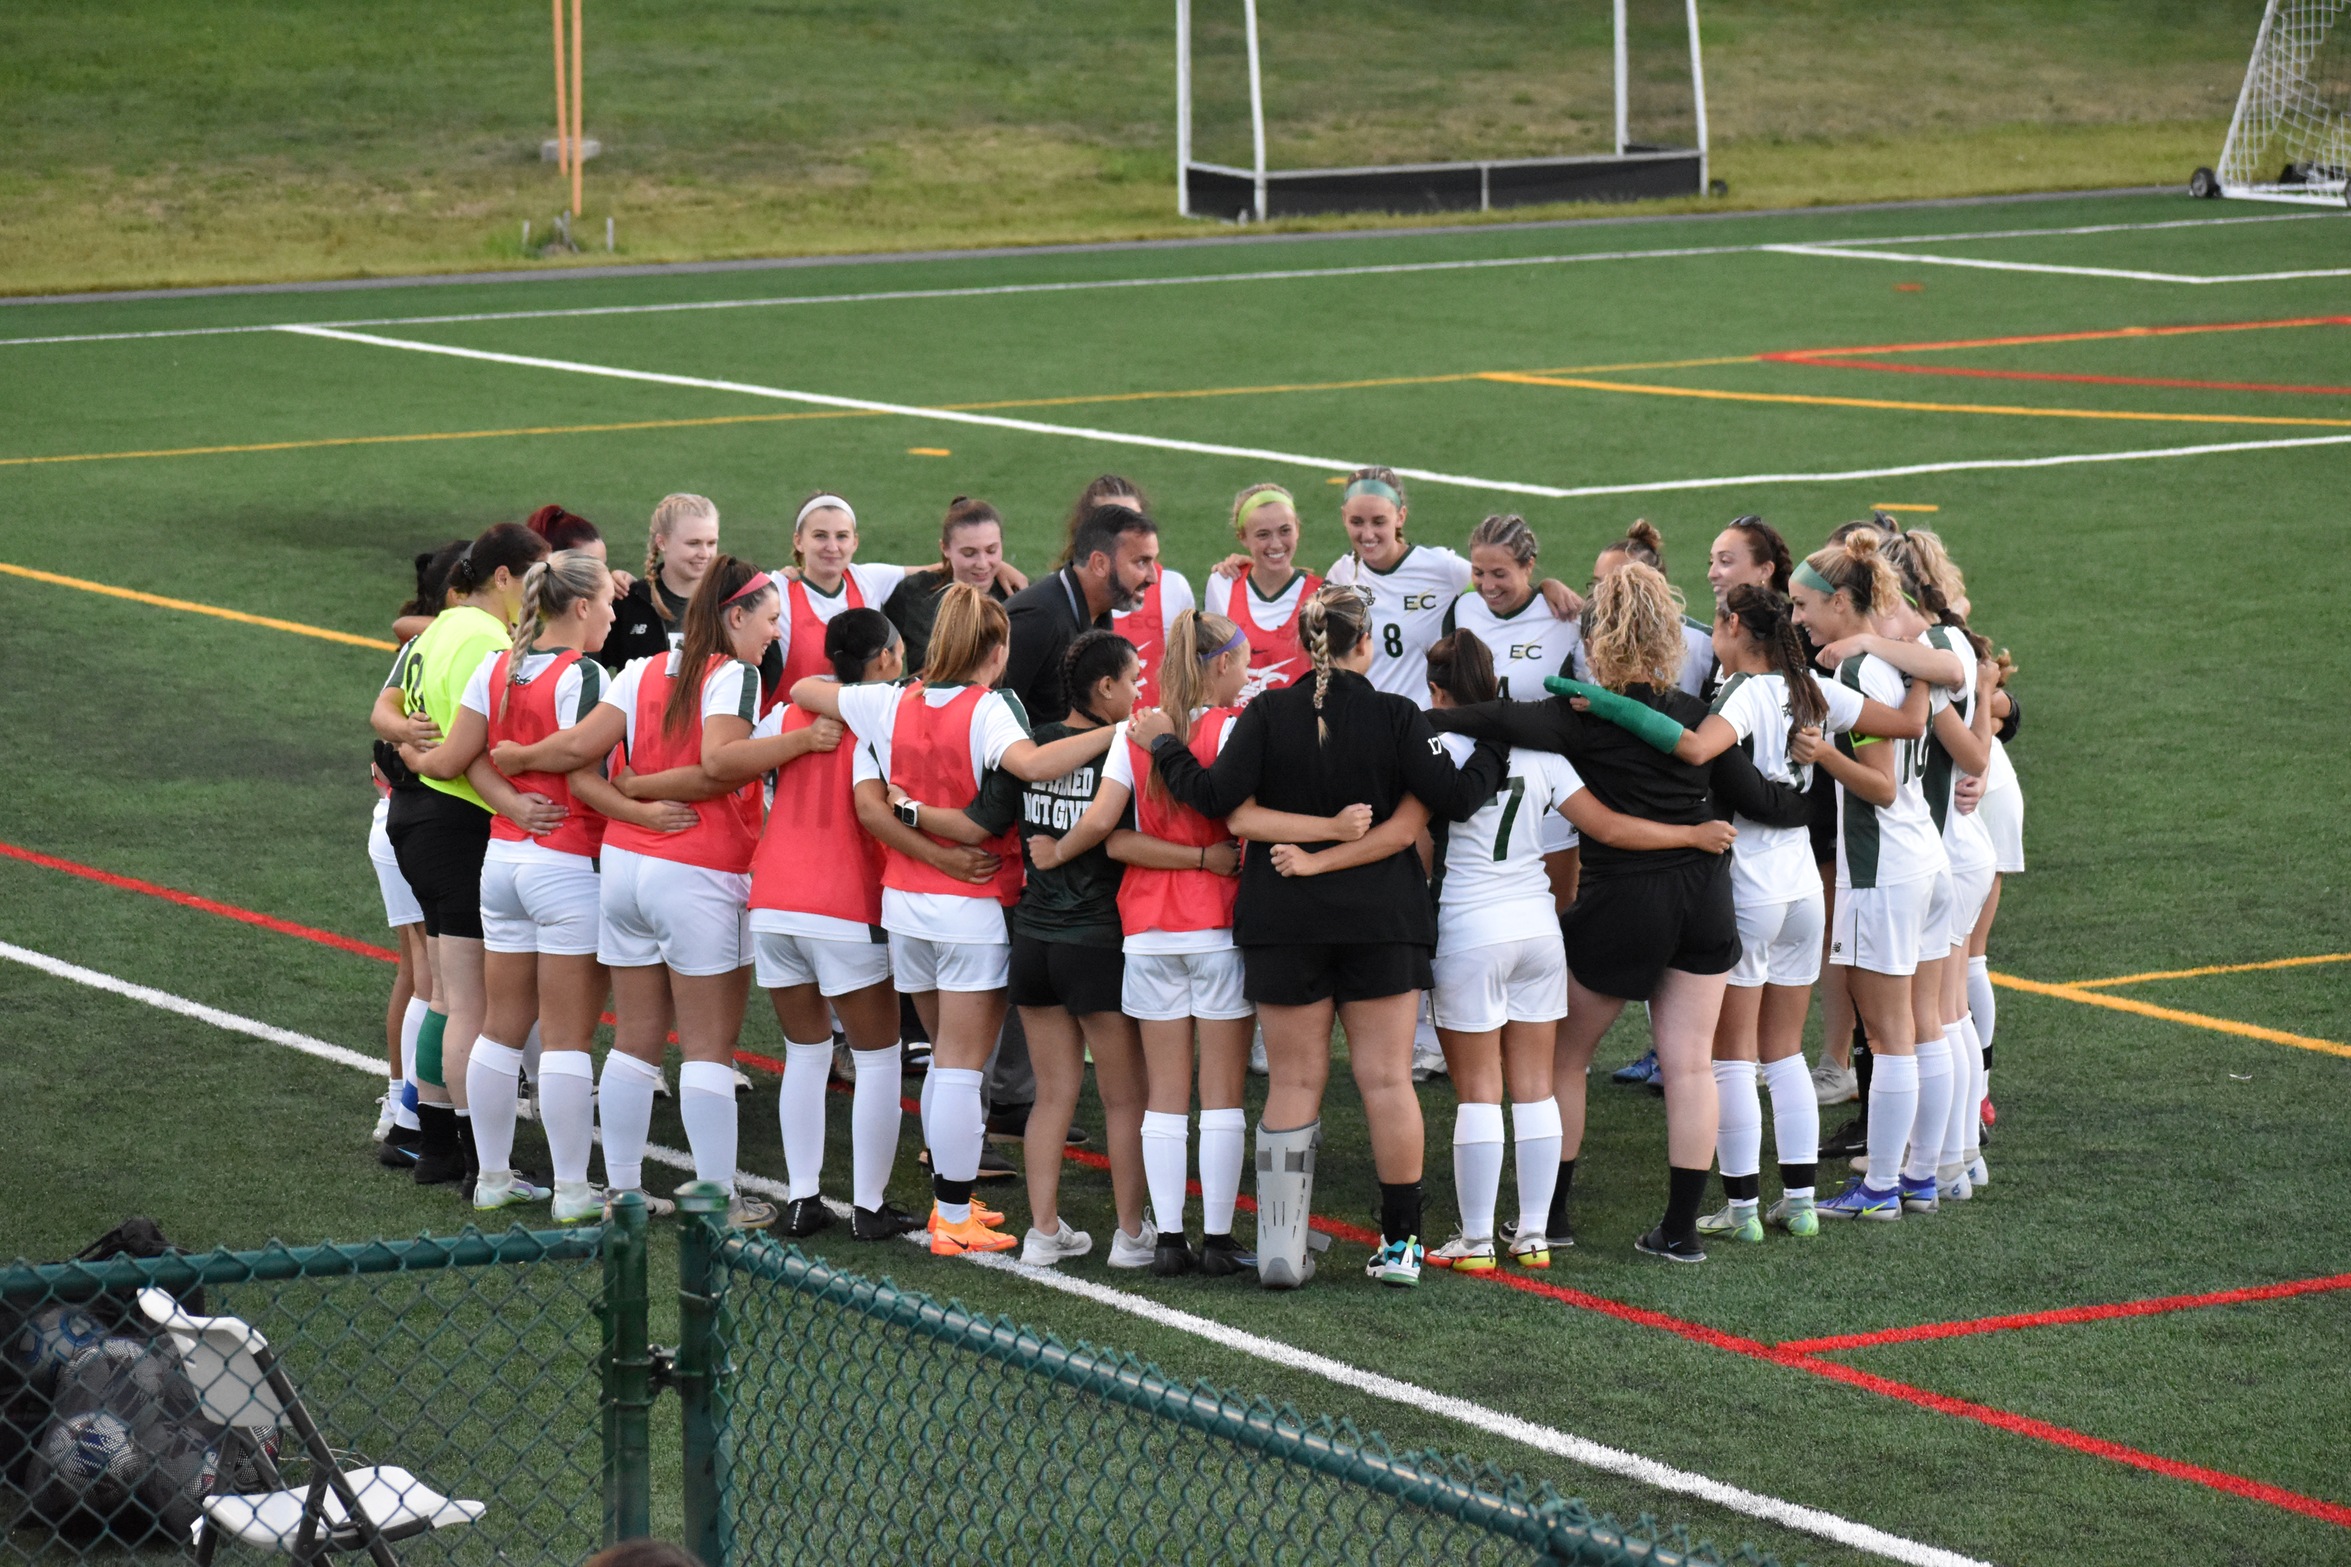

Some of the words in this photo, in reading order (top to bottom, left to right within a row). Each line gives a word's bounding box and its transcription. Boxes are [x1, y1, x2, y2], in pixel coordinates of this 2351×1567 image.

[1403, 593, 1437, 611] EC
[1382, 622, 1404, 658] 8
[1509, 644, 1543, 660] EC
[1427, 736, 1443, 755] 17
[1022, 792, 1052, 825] NOT
